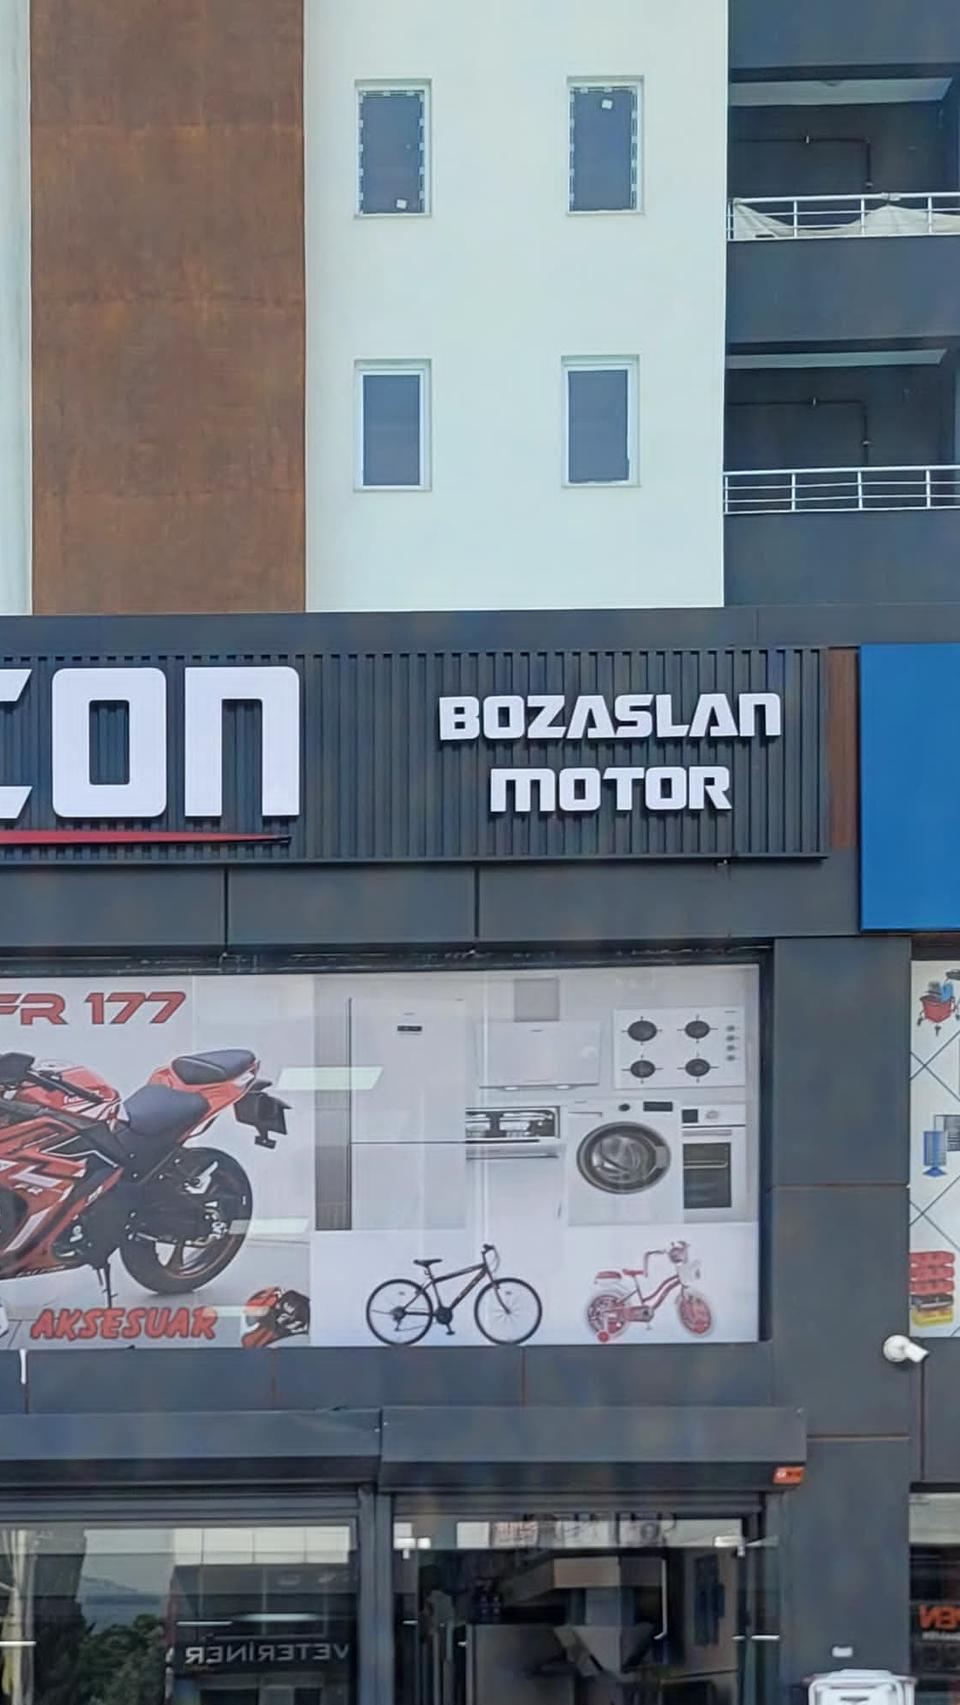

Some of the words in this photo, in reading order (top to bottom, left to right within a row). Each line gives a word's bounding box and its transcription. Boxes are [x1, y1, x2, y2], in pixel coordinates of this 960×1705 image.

[440, 693, 781, 740] BOZASLAN
[490, 766, 732, 813] MOTOR
[84, 991, 187, 1025] 177
[30, 1306, 219, 1341] AKSESUAR
